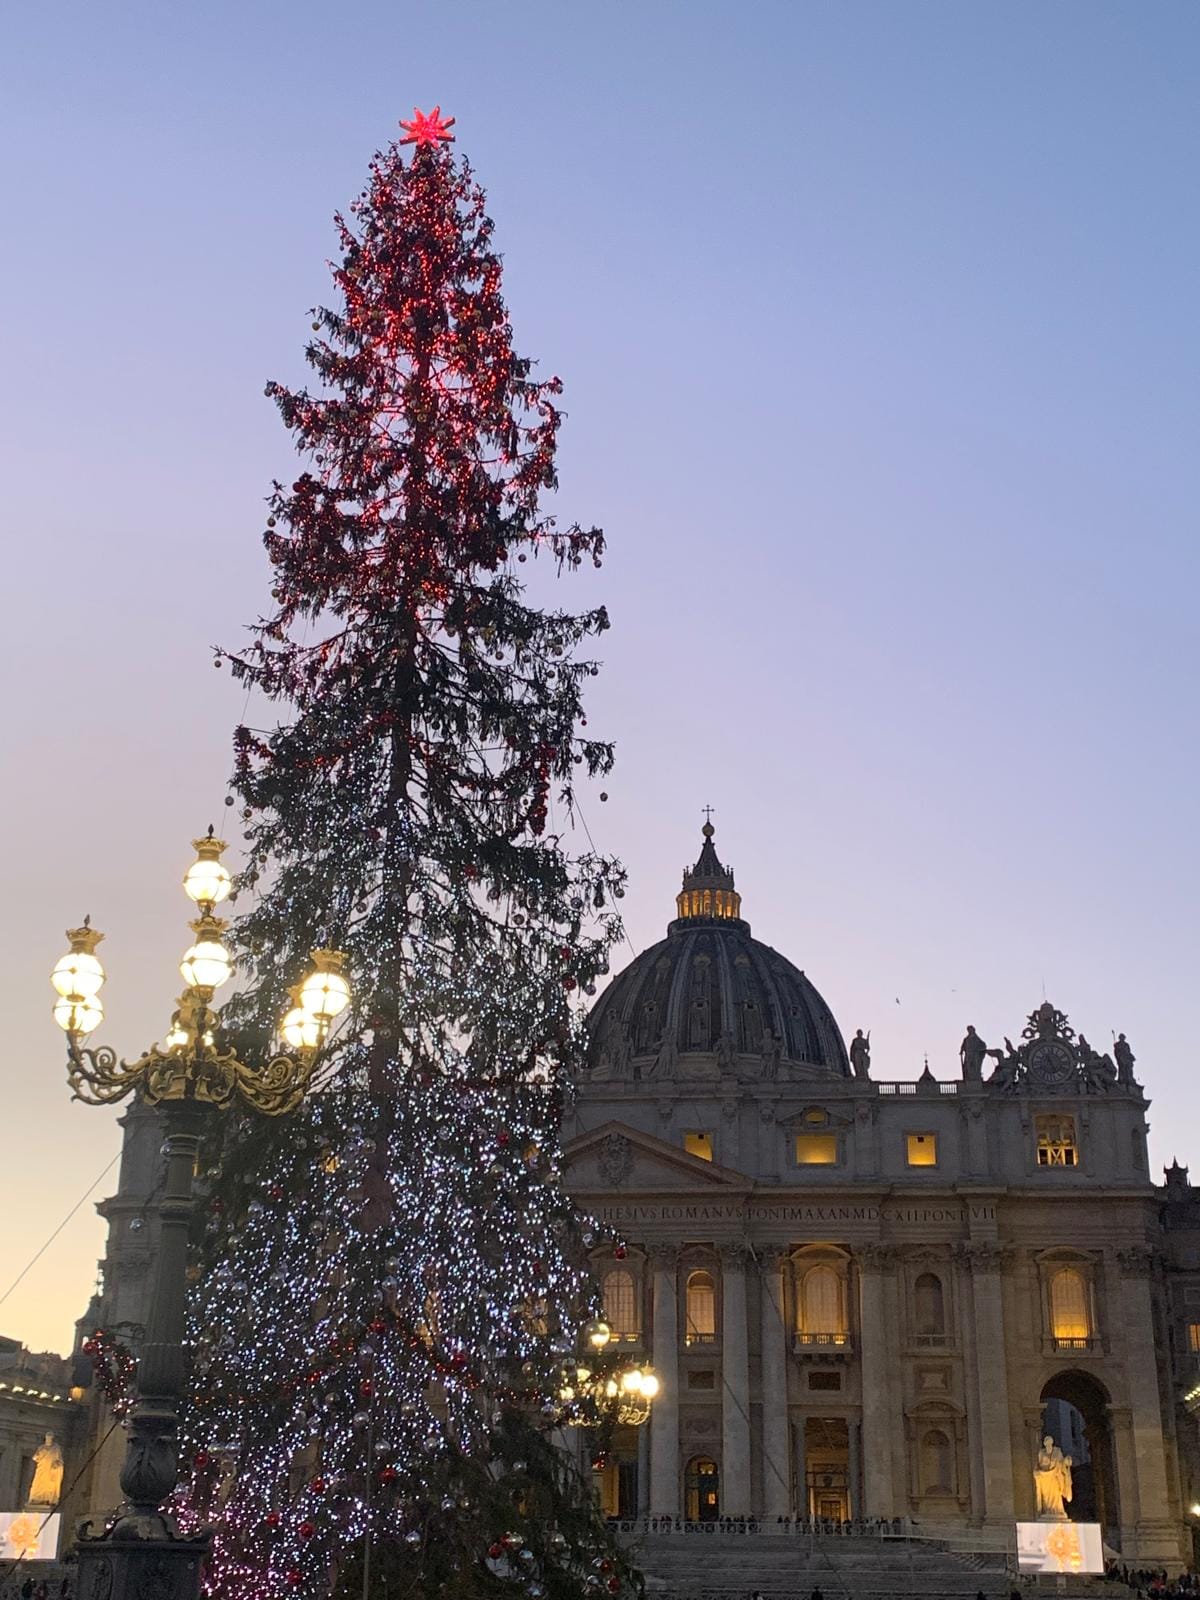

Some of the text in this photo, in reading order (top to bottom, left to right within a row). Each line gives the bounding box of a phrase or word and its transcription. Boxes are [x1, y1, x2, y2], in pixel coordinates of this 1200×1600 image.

[662, 1206, 743, 1219] ROMANVS
[747, 1207, 789, 1220] PONT
[790, 1207, 825, 1220] MAX
[829, 1207, 849, 1220] AN
[971, 1207, 994, 1219] VII
